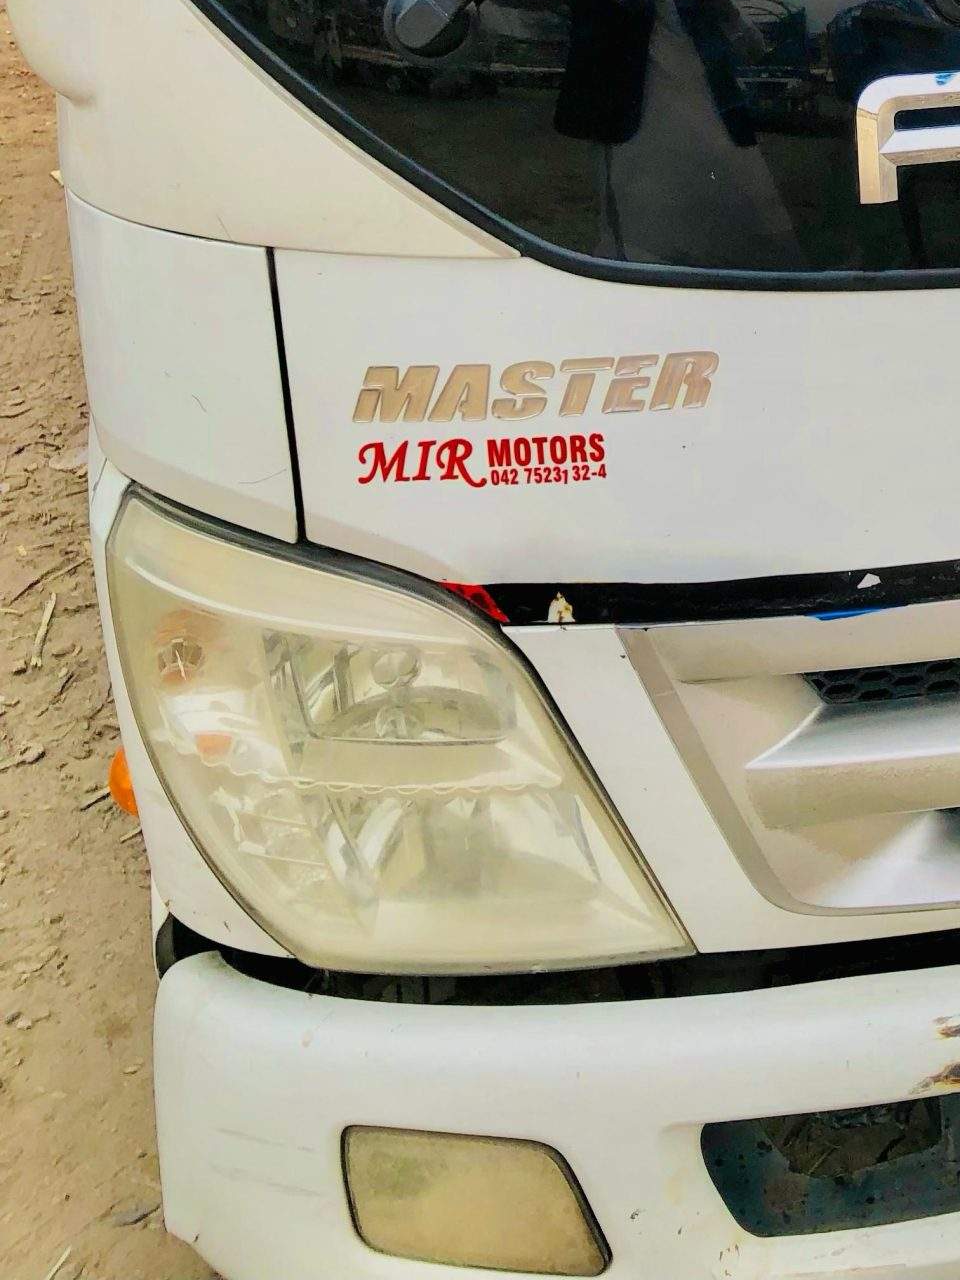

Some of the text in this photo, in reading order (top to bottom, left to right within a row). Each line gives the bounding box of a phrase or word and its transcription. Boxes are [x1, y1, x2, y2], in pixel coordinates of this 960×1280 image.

[352, 350, 719, 423] MASTER
[358, 433, 606, 488] MIR MOTORS
[490, 468, 520, 486] 042
